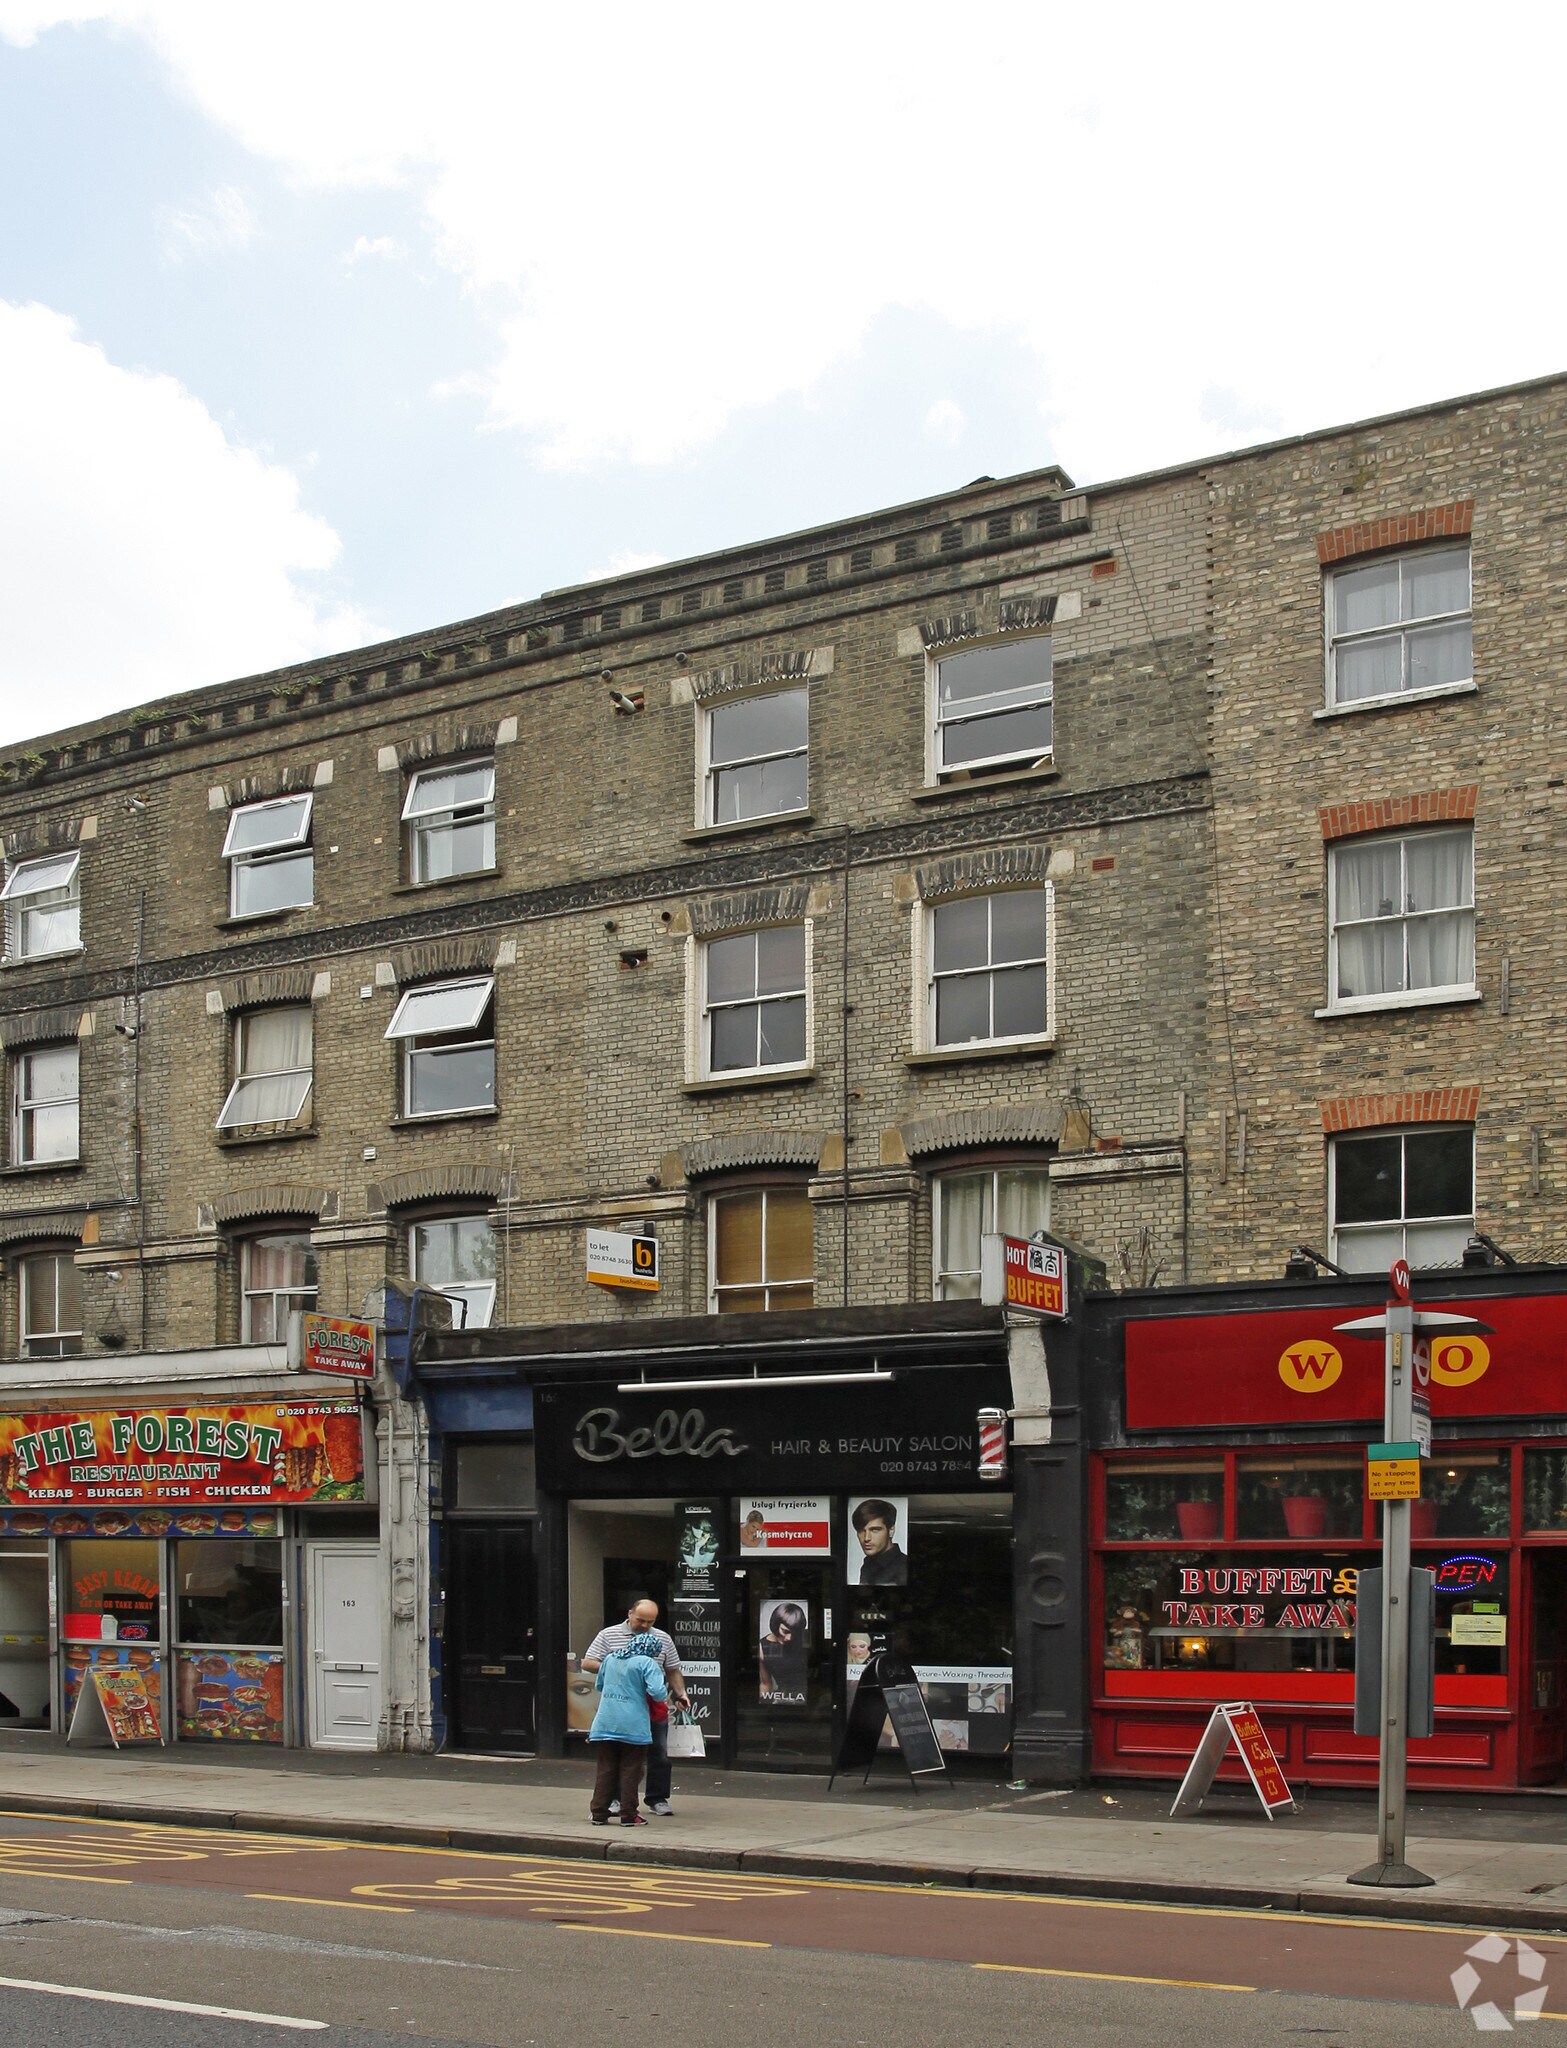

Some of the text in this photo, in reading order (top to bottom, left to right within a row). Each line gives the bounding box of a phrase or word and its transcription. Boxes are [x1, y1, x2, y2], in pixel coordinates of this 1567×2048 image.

[589, 1242, 609, 1252] to let
[636, 1242, 652, 1267] b
[1006, 1246, 1026, 1266] HOT
[1007, 1274, 1060, 1309] BUFFET
[306, 1330, 371, 1356] FOREST
[314, 1356, 367, 1371] TAKE AWAY
[1286, 1352, 1335, 1380] W
[1438, 1345, 1473, 1372] O
[308, 1406, 332, 1416] 8743
[334, 1405, 359, 1414] 9625
[13, 1414, 282, 1472] THE FOREST
[572, 1407, 749, 1462] Bella
[771, 1436, 972, 1454] HAIR & BEAUTY SALON
[70, 1463, 220, 1482] RESTAURANT
[880, 1460, 972, 1472] 020 8743 7854
[28, 1488, 74, 1499] KEBAB
[87, 1488, 143, 1498] BURGER
[157, 1486, 190, 1497] FISH
[205, 1486, 271, 1496] CHICKEN
[752, 1500, 816, 1509] Usługi fryzjersko
[756, 1530, 813, 1540] Kosmetyczne
[1180, 1568, 1332, 1595] BUFFET
[1425, 1564, 1497, 1583] PEN
[75, 1567, 159, 1600] BEST KEBAB
[115, 1601, 132, 1609] TAKE
[134, 1602, 153, 1610] AWAY
[1163, 1602, 1265, 1628] TAKE
[123, 1626, 146, 1638] OPEN
[680, 1664, 716, 1674] Highlight
[100, 1678, 139, 1689] FOREST
[686, 1684, 711, 1695] alon
[762, 1692, 805, 1701] WELLA
[1235, 1722, 1260, 1737] Buffet
[351, 1870, 811, 1915] BUS
